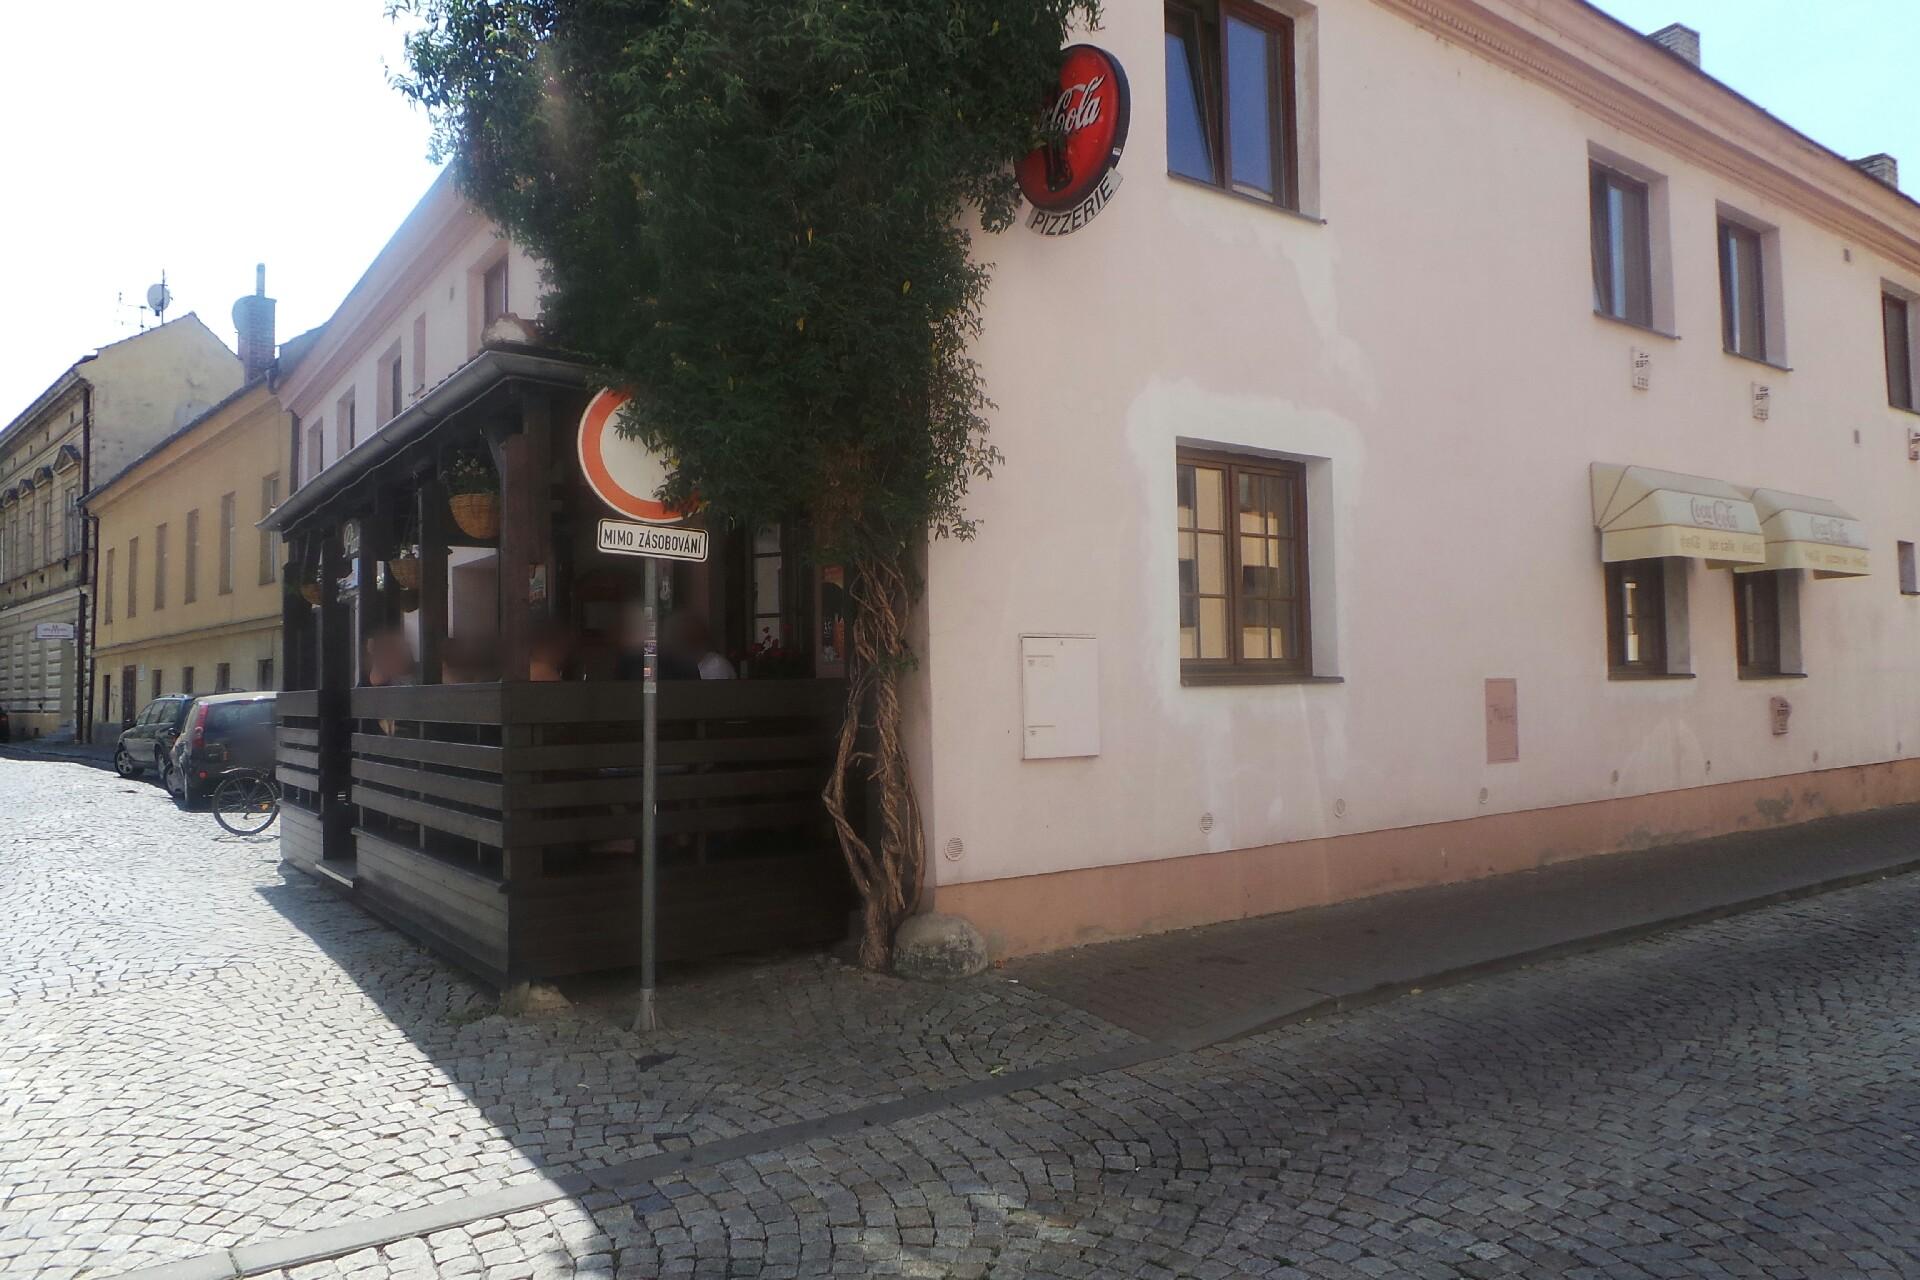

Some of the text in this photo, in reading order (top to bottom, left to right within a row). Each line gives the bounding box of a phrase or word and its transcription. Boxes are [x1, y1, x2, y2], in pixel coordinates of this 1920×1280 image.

[1030, 175, 1113, 235] PIZZERIE
[603, 529, 702, 554] MIMO ZÁSOBOVÁNÍ
